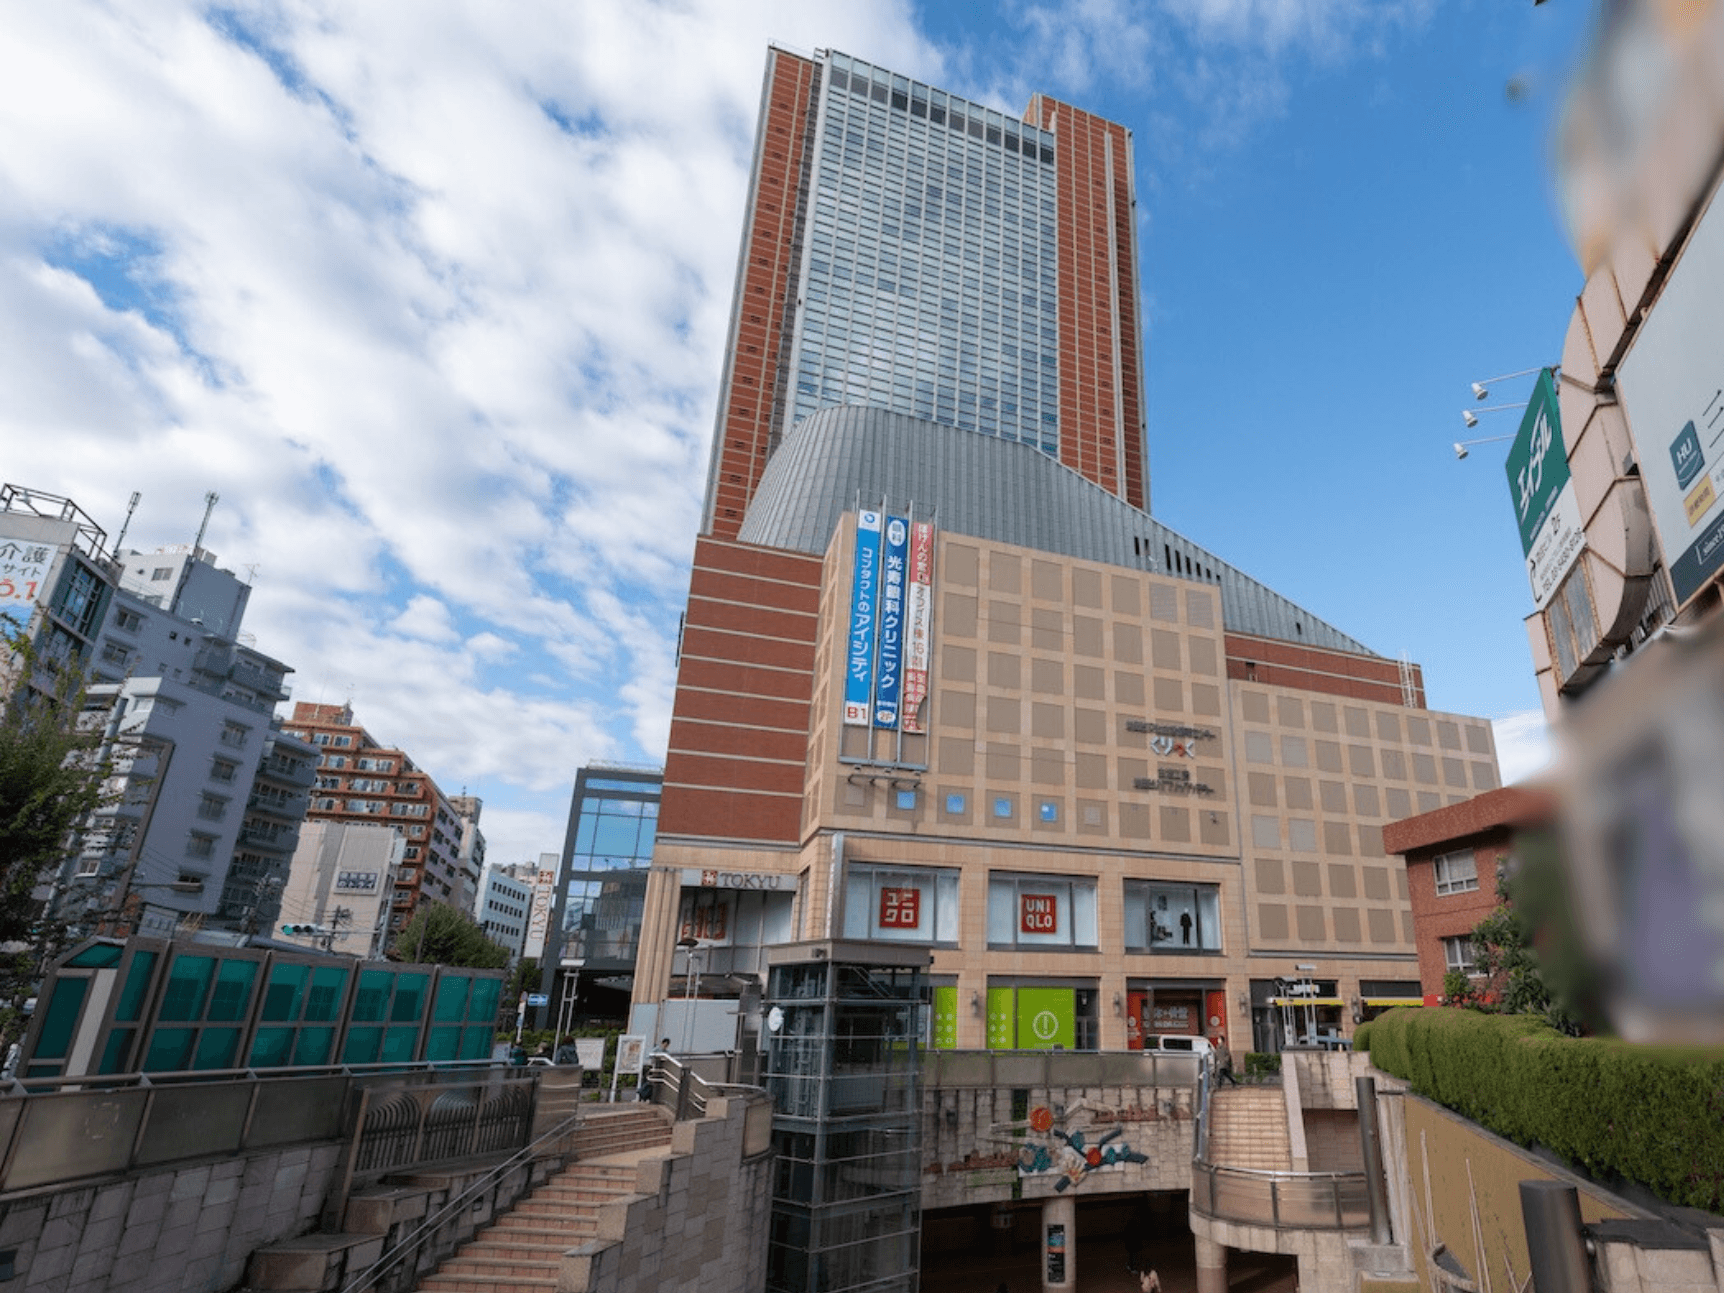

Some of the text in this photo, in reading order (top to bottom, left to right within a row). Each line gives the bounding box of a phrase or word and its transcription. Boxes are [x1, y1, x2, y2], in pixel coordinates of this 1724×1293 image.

[0, 542, 50, 565] 介護
[847, 706, 866, 719] B1
[720, 873, 780, 889] TOKYU
[529, 887, 551, 940] TOKYU
[1025, 899, 1052, 913] UNI
[1025, 914, 1053, 930] QLO
